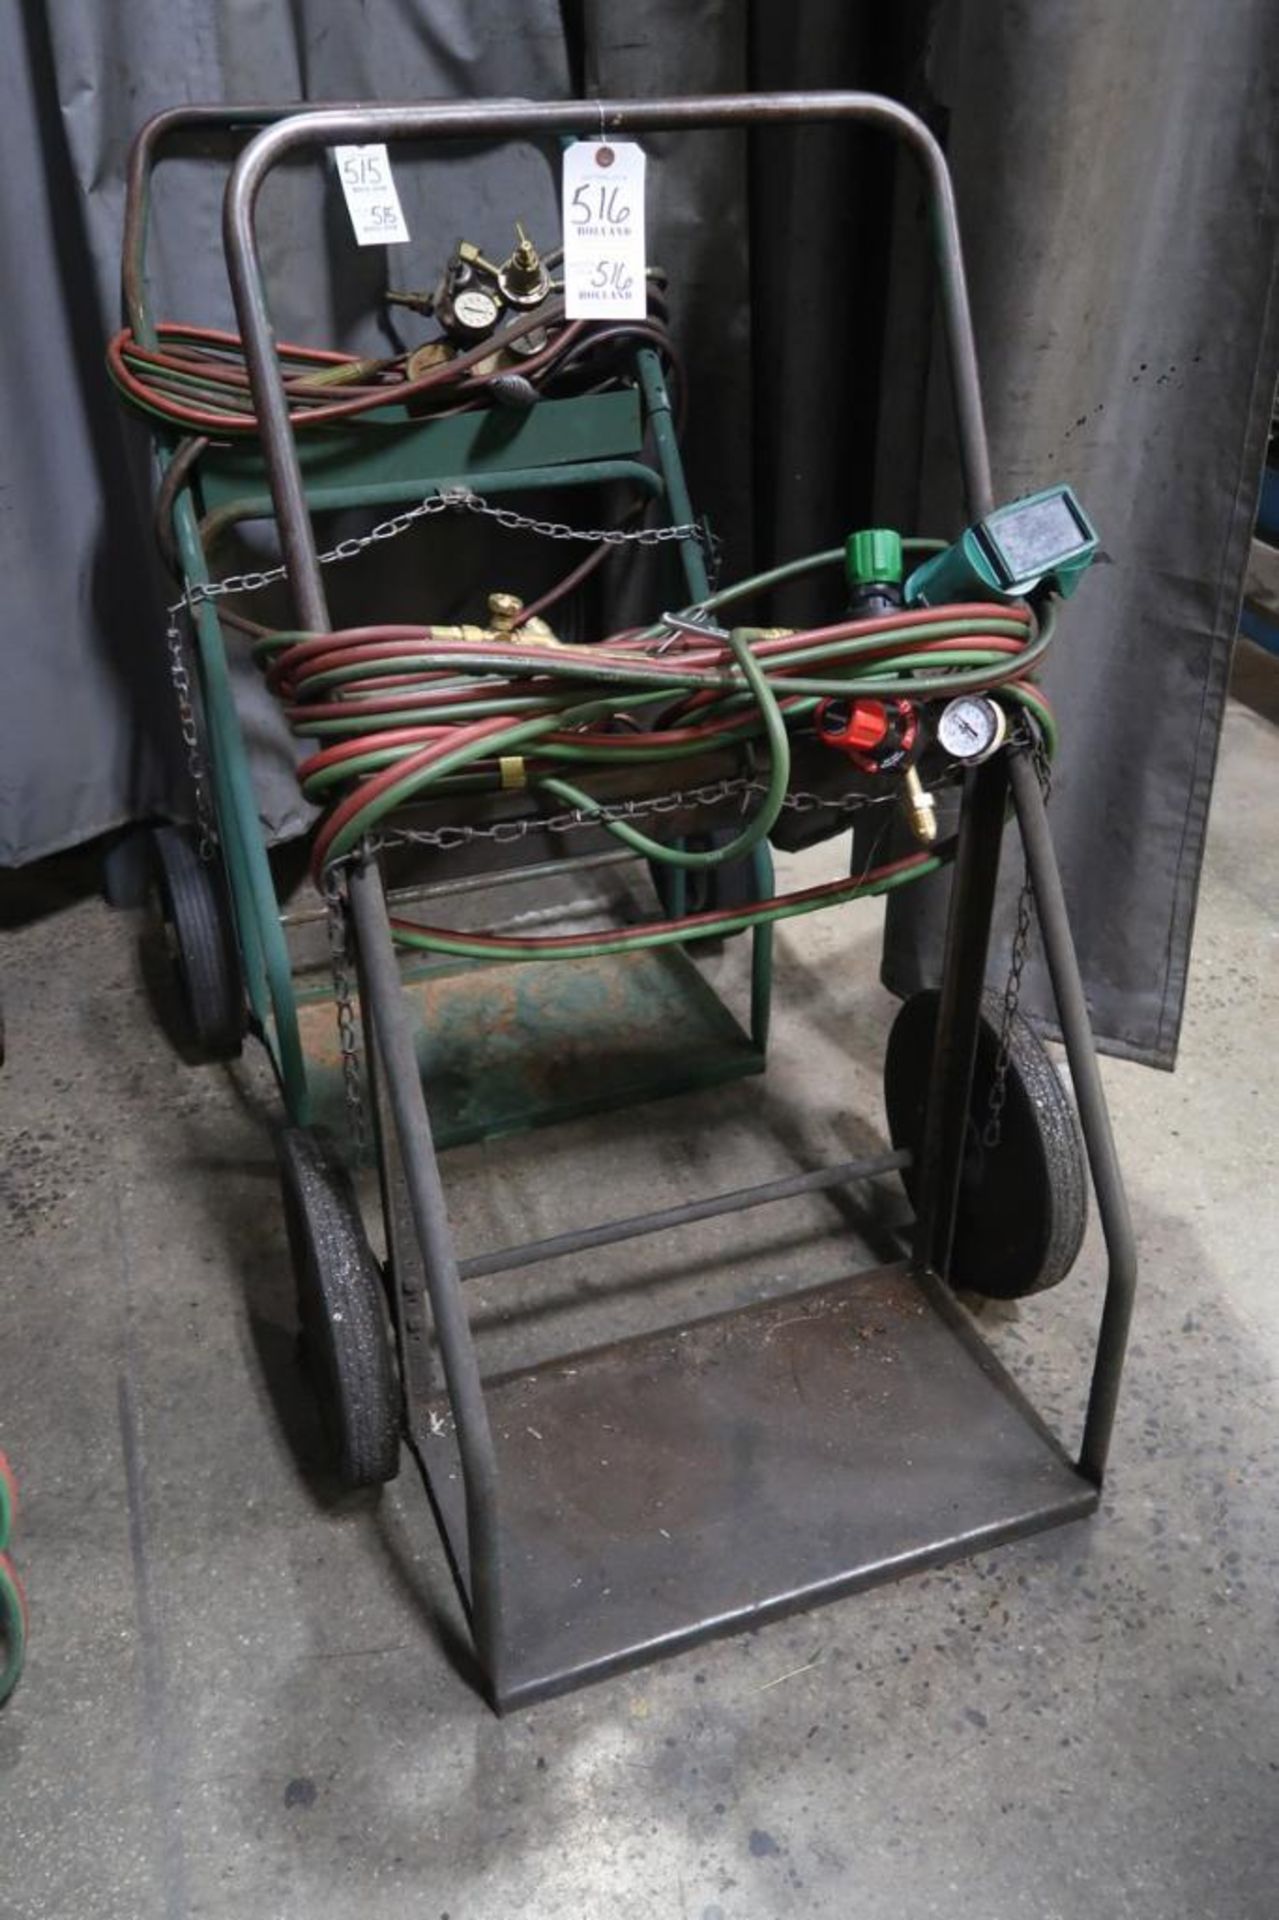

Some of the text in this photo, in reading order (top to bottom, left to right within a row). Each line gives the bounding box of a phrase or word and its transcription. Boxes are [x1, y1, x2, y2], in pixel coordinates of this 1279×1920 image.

[344, 157, 382, 184] 515
[571, 183, 631, 225] 516
[577, 226, 632, 236] HOLLAND
[591, 261, 633, 290] 516
